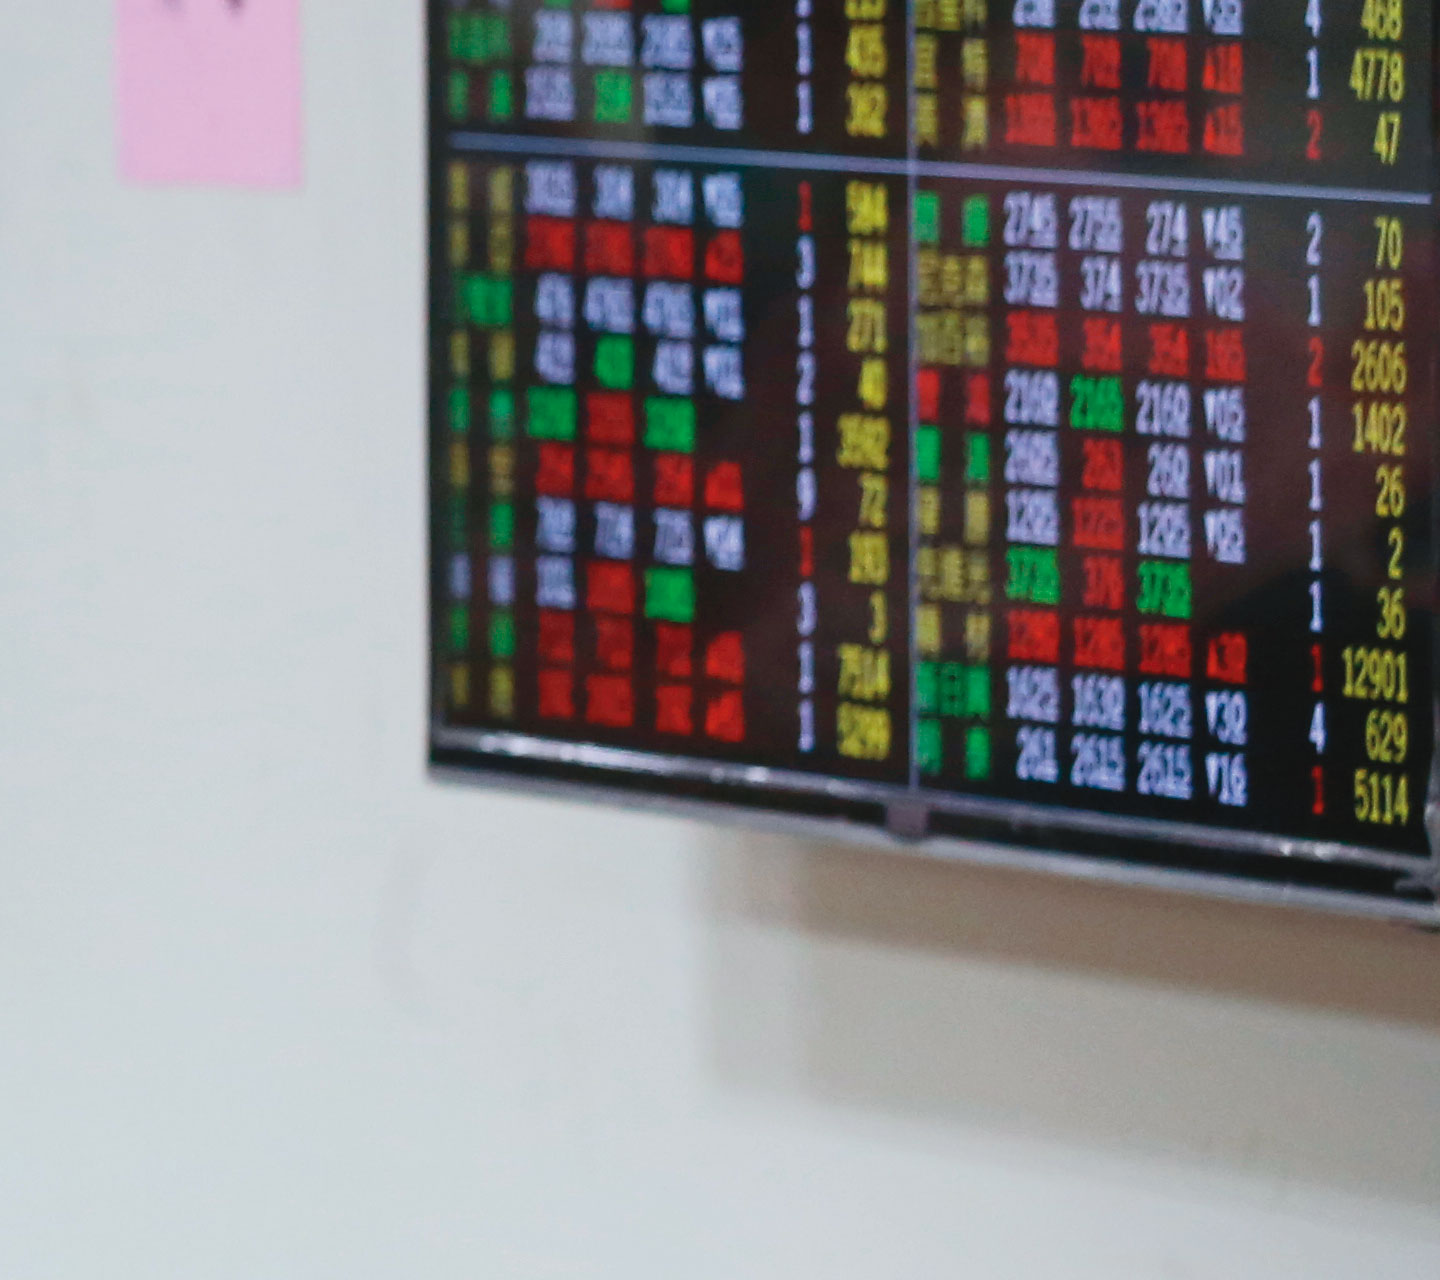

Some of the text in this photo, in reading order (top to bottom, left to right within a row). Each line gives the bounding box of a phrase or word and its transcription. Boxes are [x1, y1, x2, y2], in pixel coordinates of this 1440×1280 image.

[1306, 46, 1404, 102] 1 4778
[1306, 109, 1321, 160] 2
[1373, 111, 1401, 166] 47
[1146, 200, 1188, 257] 274
[1213, 205, 1244, 261] 45
[1306, 212, 1322, 266] 2
[1375, 215, 1402, 270] 70
[1080, 256, 1123, 313] 374
[1213, 266, 1244, 322] 02
[1307, 273, 1320, 327] 1
[1364, 278, 1404, 332] 105
[1308, 336, 1324, 388] 2
[1352, 339, 1407, 394] 2606
[1135, 380, 1190, 439] 2160
[1307, 395, 1321, 450] 1
[1352, 402, 1407, 457] 1402
[1308, 457, 1322, 511] 1
[1375, 463, 1405, 517] 26
[1309, 520, 1322, 572] 1
[1388, 526, 1403, 580] 2
[1309, 580, 1323, 633] 1
[1377, 586, 1406, 640] 36
[1310, 643, 1324, 693] 1
[1342, 646, 1408, 704] 12901
[1217, 689, 1247, 747] 30
[1309, 701, 1326, 754] 4
[1366, 709, 1407, 764] 629
[1137, 740, 1192, 800] 2615
[1219, 751, 1248, 807] 16
[1311, 765, 1324, 815] 1
[1354, 767, 1409, 825] 5114
